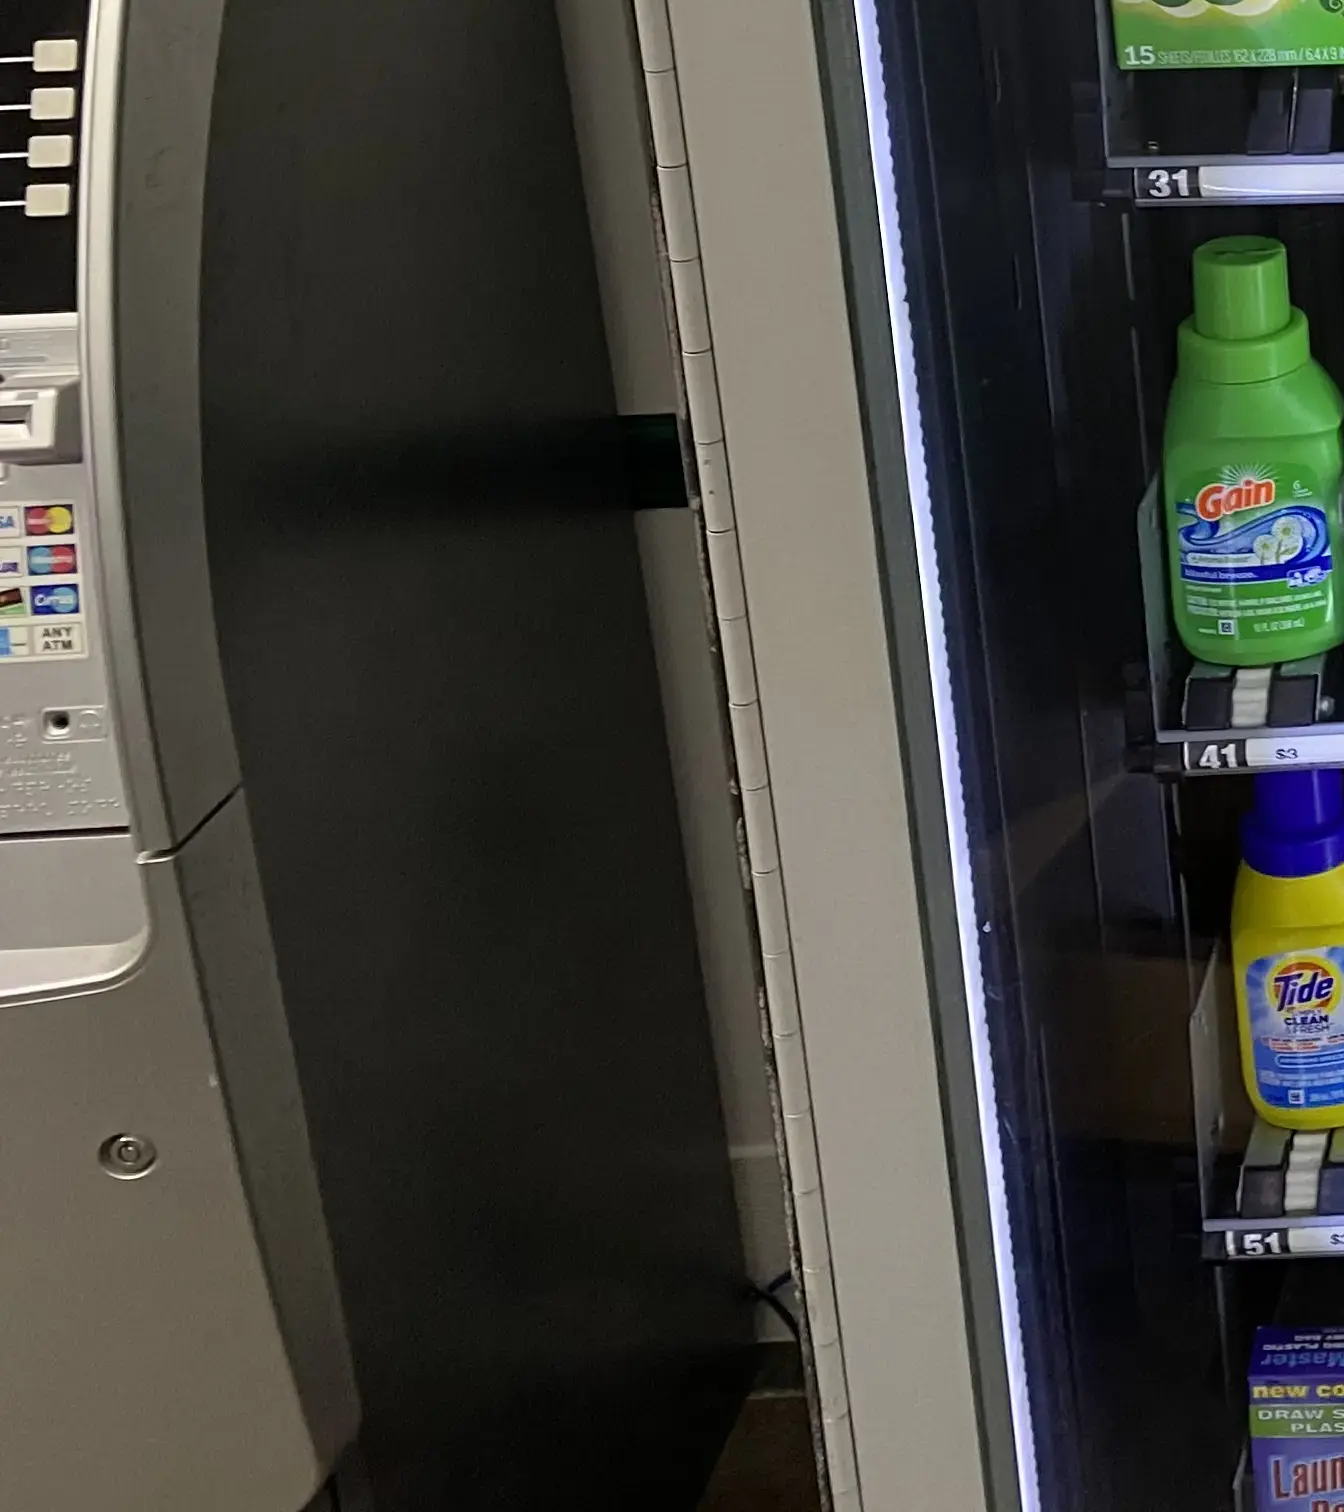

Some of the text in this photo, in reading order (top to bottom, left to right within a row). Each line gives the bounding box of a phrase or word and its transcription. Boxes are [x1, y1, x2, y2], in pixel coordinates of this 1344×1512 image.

[1125, 45, 1156, 65] 15
[1148, 169, 1190, 198] 31
[1196, 479, 1275, 521] Gain
[43, 627, 72, 638] ANY
[43, 640, 73, 651] ATM
[1199, 744, 1298, 769] 41 $3
[1274, 971, 1334, 1012] Tide
[1284, 1015, 1329, 1026] CLEAN
[1243, 1234, 1283, 1256] 51
[1252, 1384, 1307, 1399] new
[1258, 1409, 1325, 1421] DRAW
